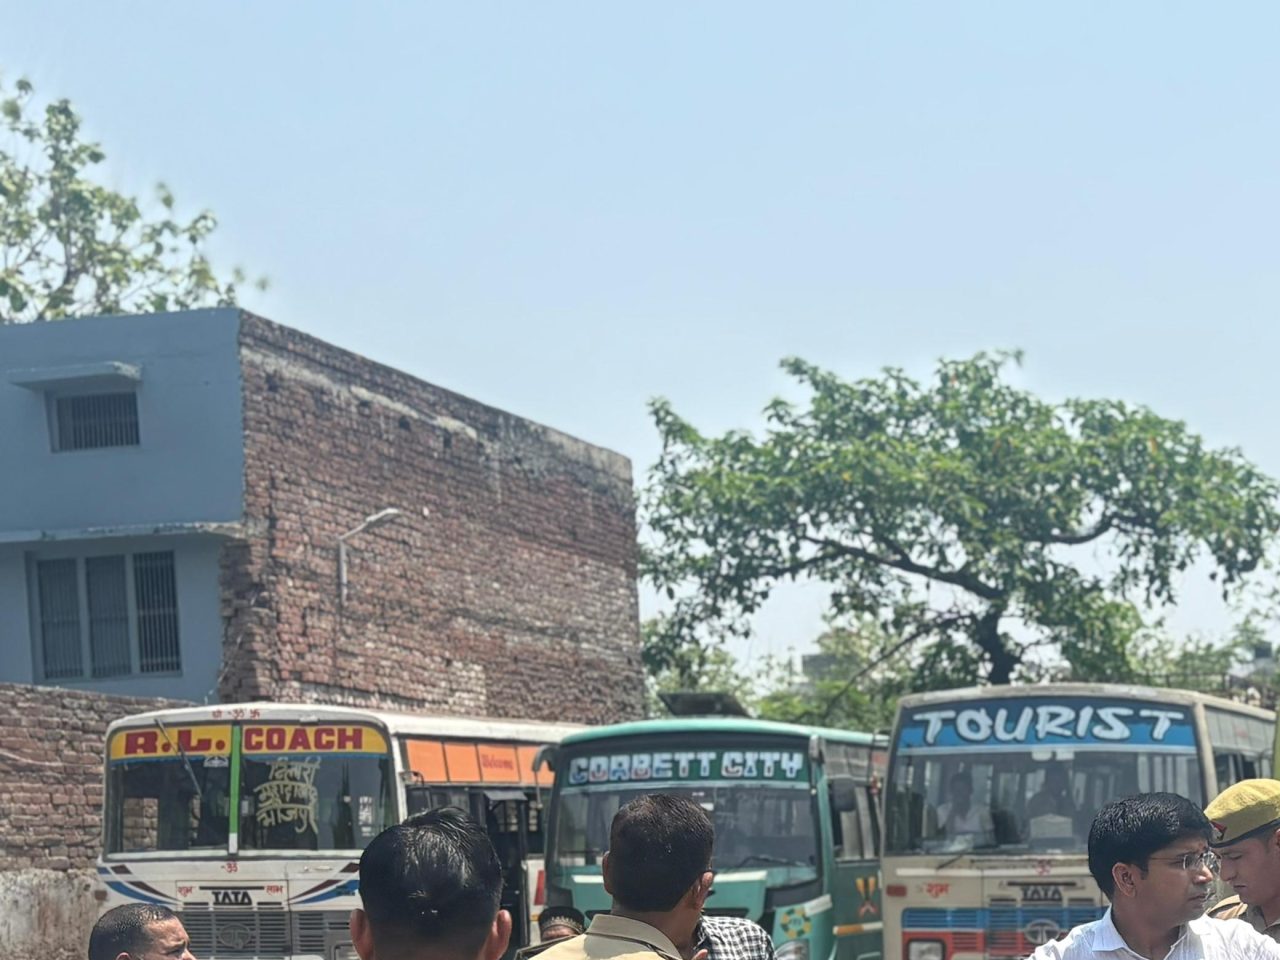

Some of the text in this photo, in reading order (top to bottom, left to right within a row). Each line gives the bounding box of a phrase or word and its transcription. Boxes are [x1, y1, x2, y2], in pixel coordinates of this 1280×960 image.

[913, 705, 1184, 744] TOURIST
[124, 727, 363, 755] R.L. COACH
[569, 752, 804, 784] CORBETT CITY
[212, 890, 252, 905] TATA
[1021, 886, 1063, 902] TATA
